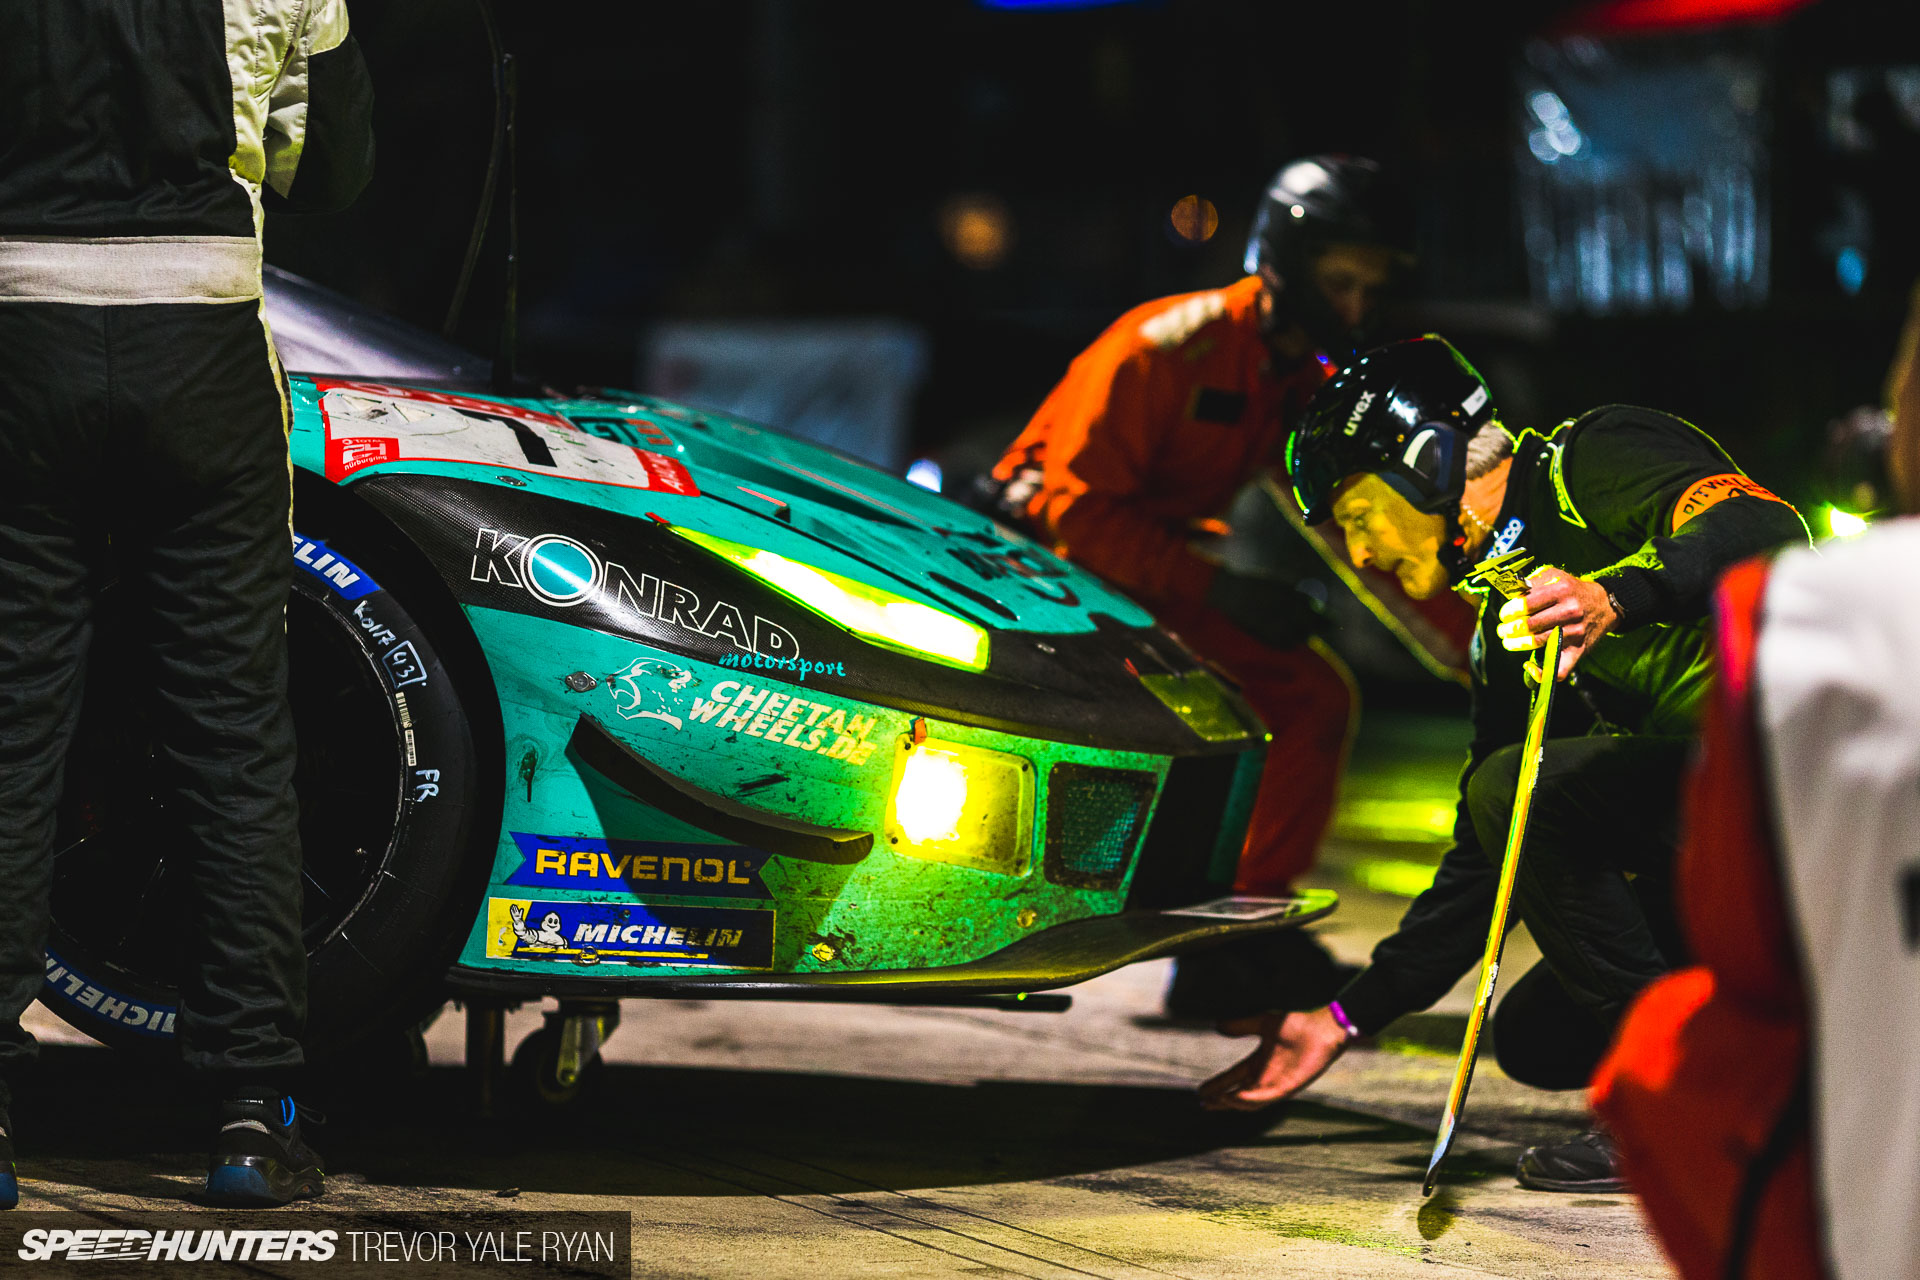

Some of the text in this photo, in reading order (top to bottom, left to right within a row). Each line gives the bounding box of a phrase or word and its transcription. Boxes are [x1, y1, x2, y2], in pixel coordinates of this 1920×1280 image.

[1344, 390, 1376, 436] uvex
[344, 455, 388, 471] nürburgring
[471, 527, 800, 662] KONRAD
[392, 652, 415, 678] 43
[718, 652, 846, 681] motorsport
[711, 680, 878, 742] CHEETAH
[688, 697, 878, 766] WHEELS.DE
[416, 769, 440, 802] FR
[535, 848, 750, 885] RAVENOL
